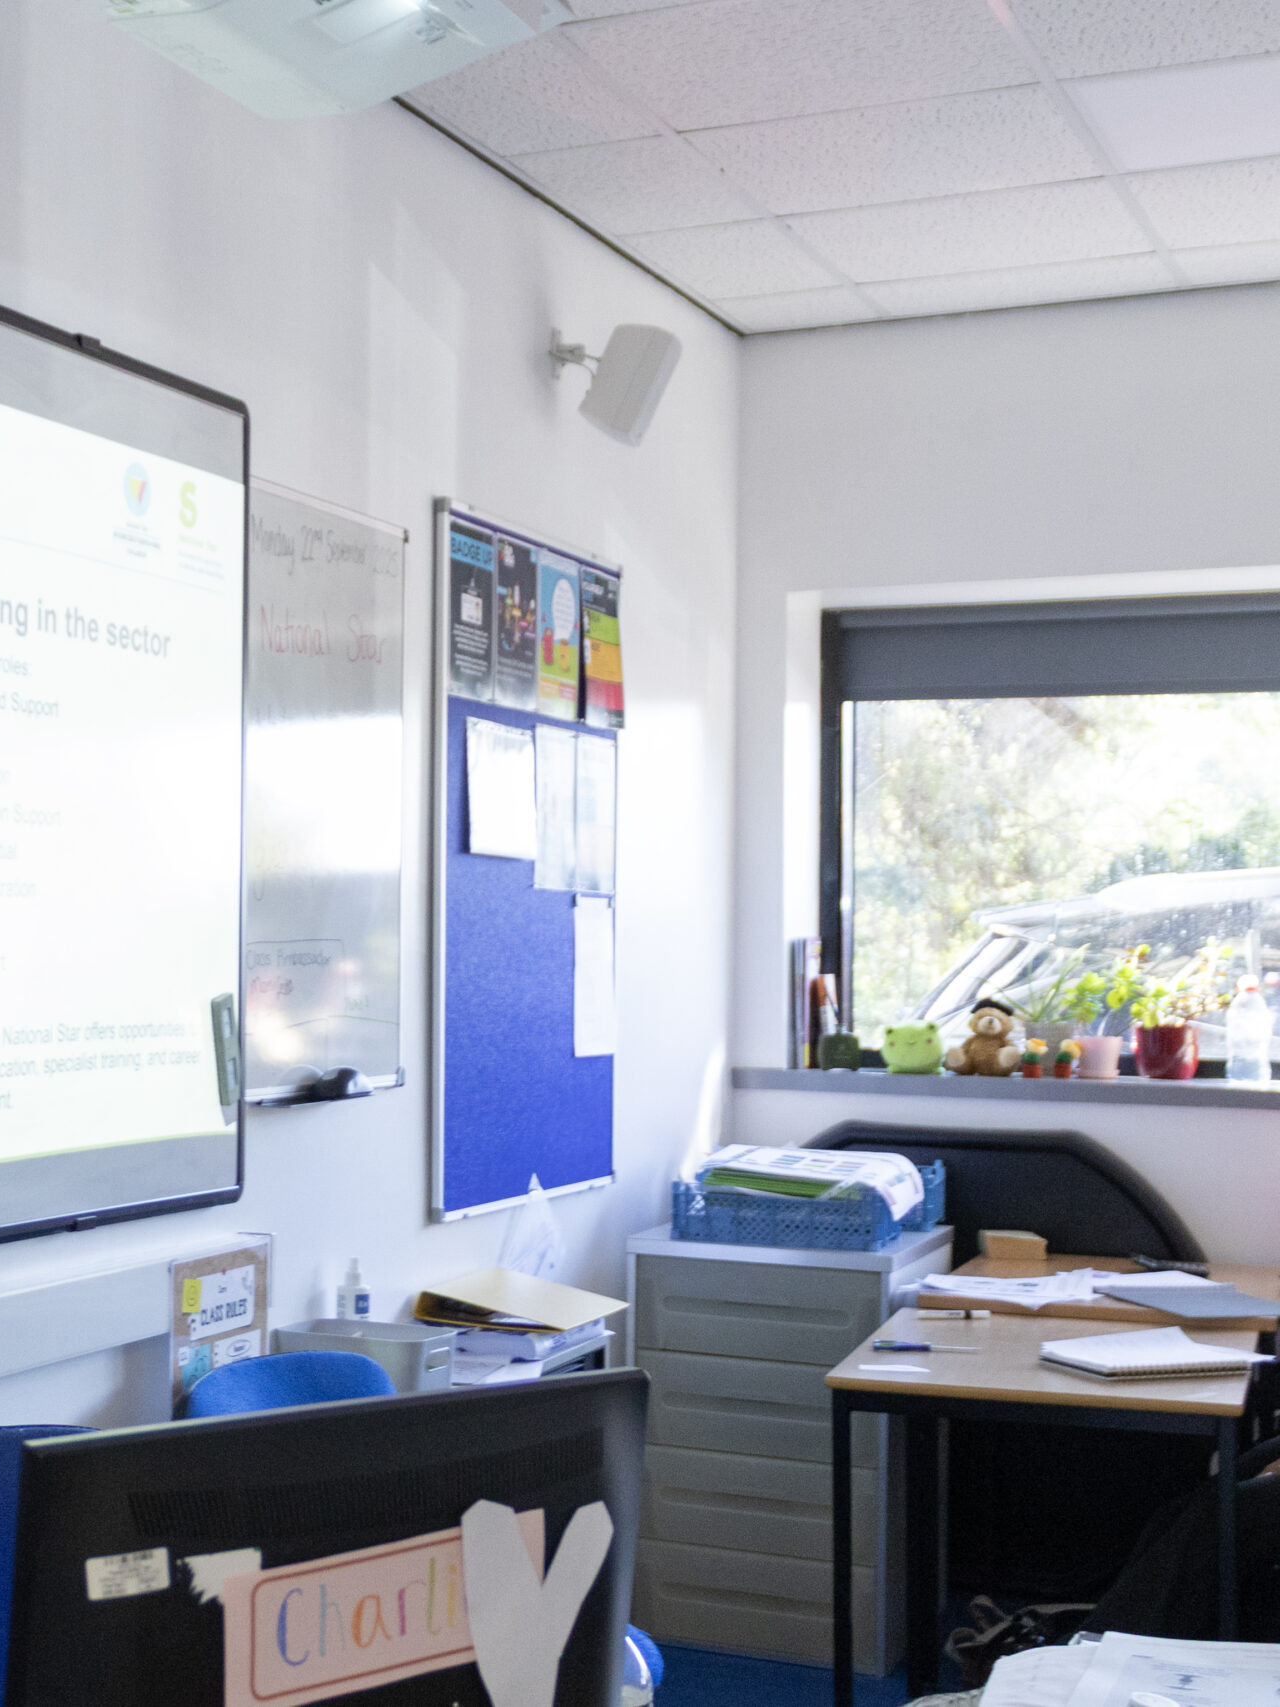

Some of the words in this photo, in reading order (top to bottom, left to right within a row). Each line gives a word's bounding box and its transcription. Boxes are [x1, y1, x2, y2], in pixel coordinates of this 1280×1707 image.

[179, 480, 198, 528] S
[37, 598, 58, 635] in
[65, 606, 100, 643] the
[106, 620, 172, 659] sector
[260, 603, 331, 658] National
[346, 613, 388, 664] Star
[10, 692, 60, 719] Support
[13, 802, 63, 830] Support
[3, 1024, 54, 1046] National
[57, 1022, 82, 1042] Star
[85, 1021, 115, 1041] offers
[119, 1022, 186, 1042] opportunities
[42, 1052, 97, 1077] specialist
[146, 1049, 167, 1065] and
[169, 1049, 201, 1065] career
[200, 1303, 224, 1327] CLASS
[276, 1556, 466, 1667] Charli
